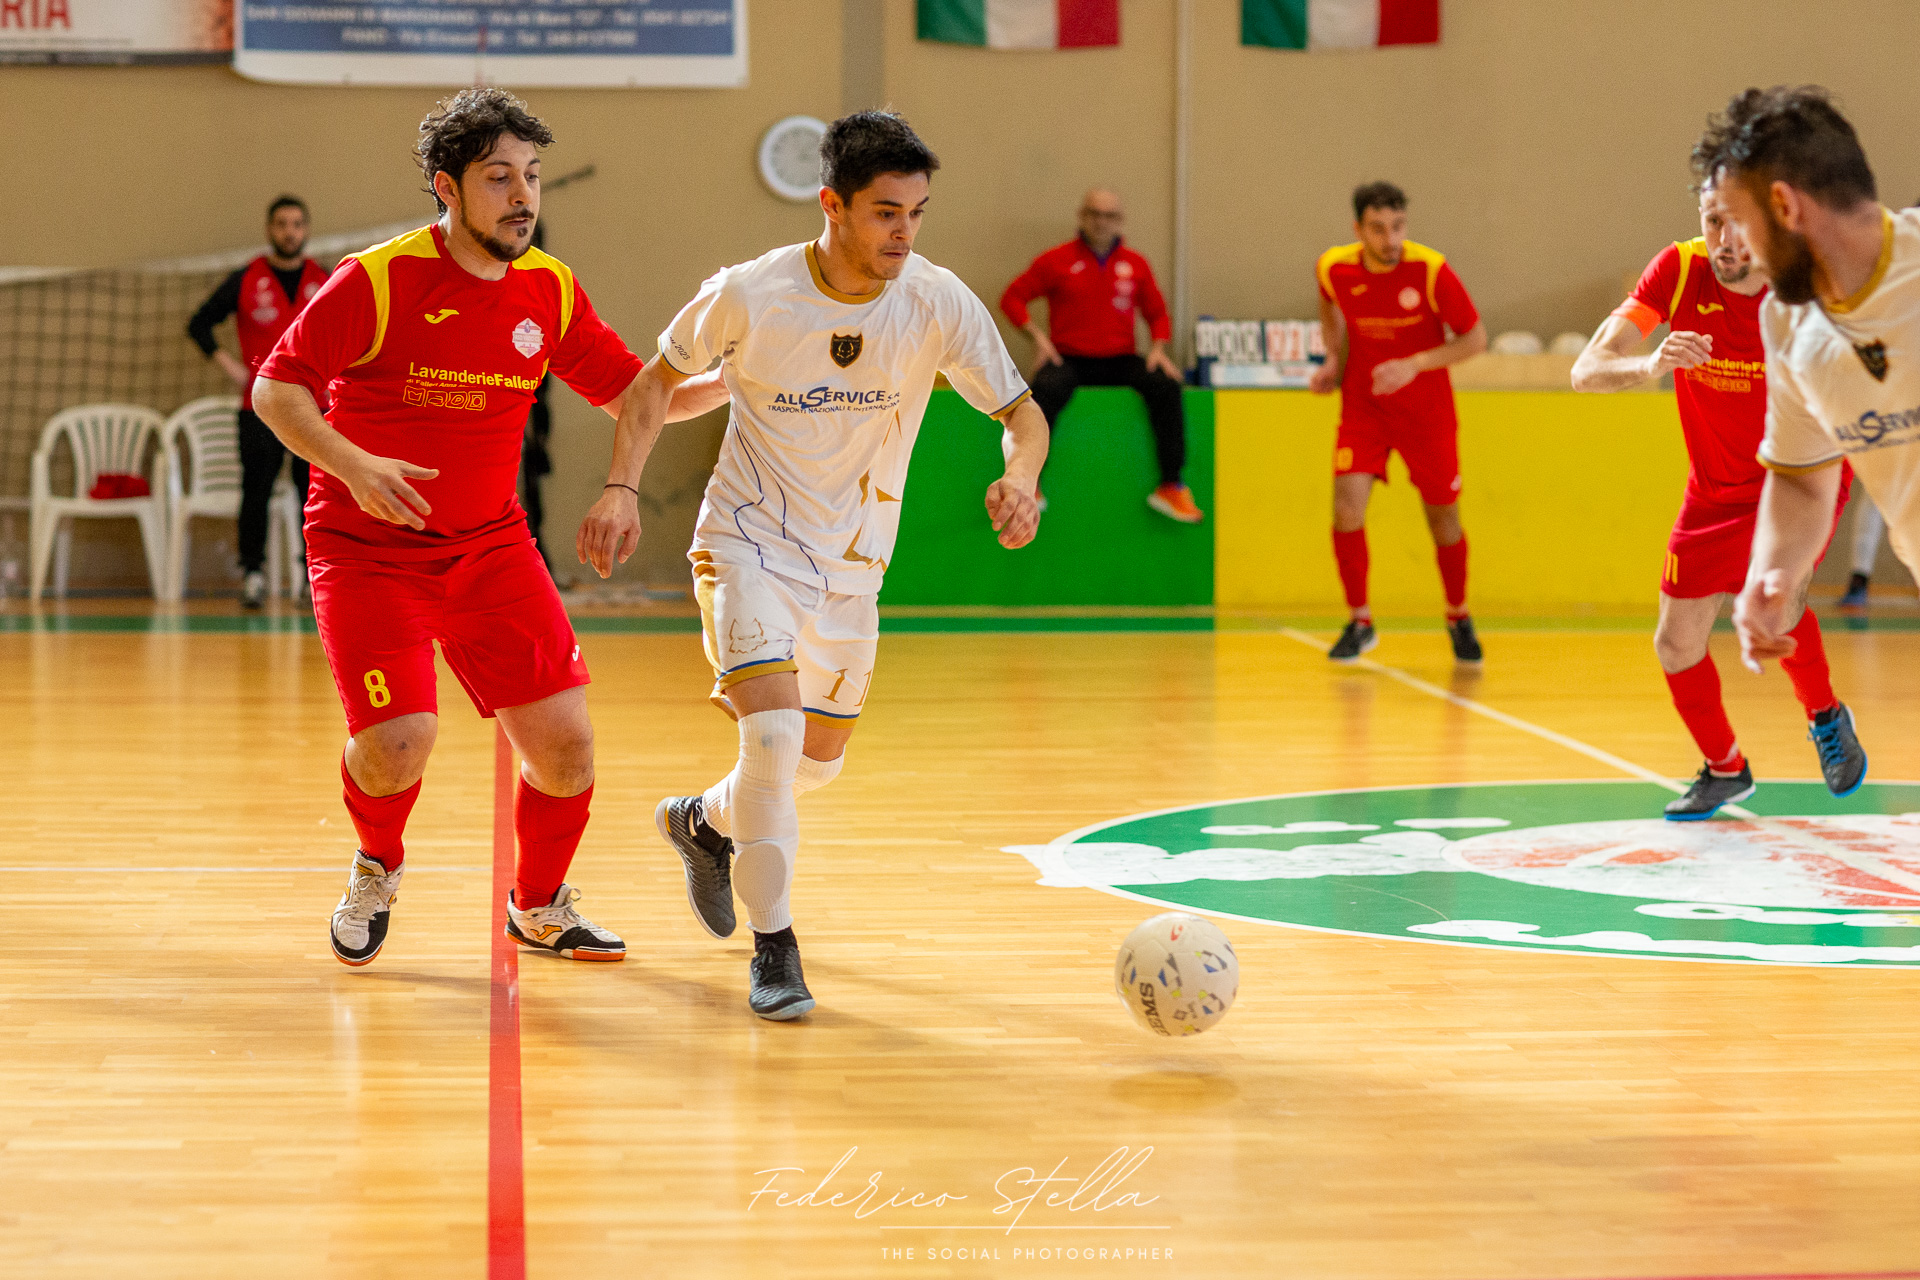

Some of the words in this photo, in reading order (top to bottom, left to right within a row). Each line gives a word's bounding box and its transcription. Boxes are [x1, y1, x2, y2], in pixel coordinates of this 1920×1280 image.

[675, 344, 691, 361] 2023
[808, 405, 846, 414] NAZIONALI
[853, 399, 900, 413] INTERNAZION
[363, 669, 391, 709] 8
[823, 668, 874, 707] 11
